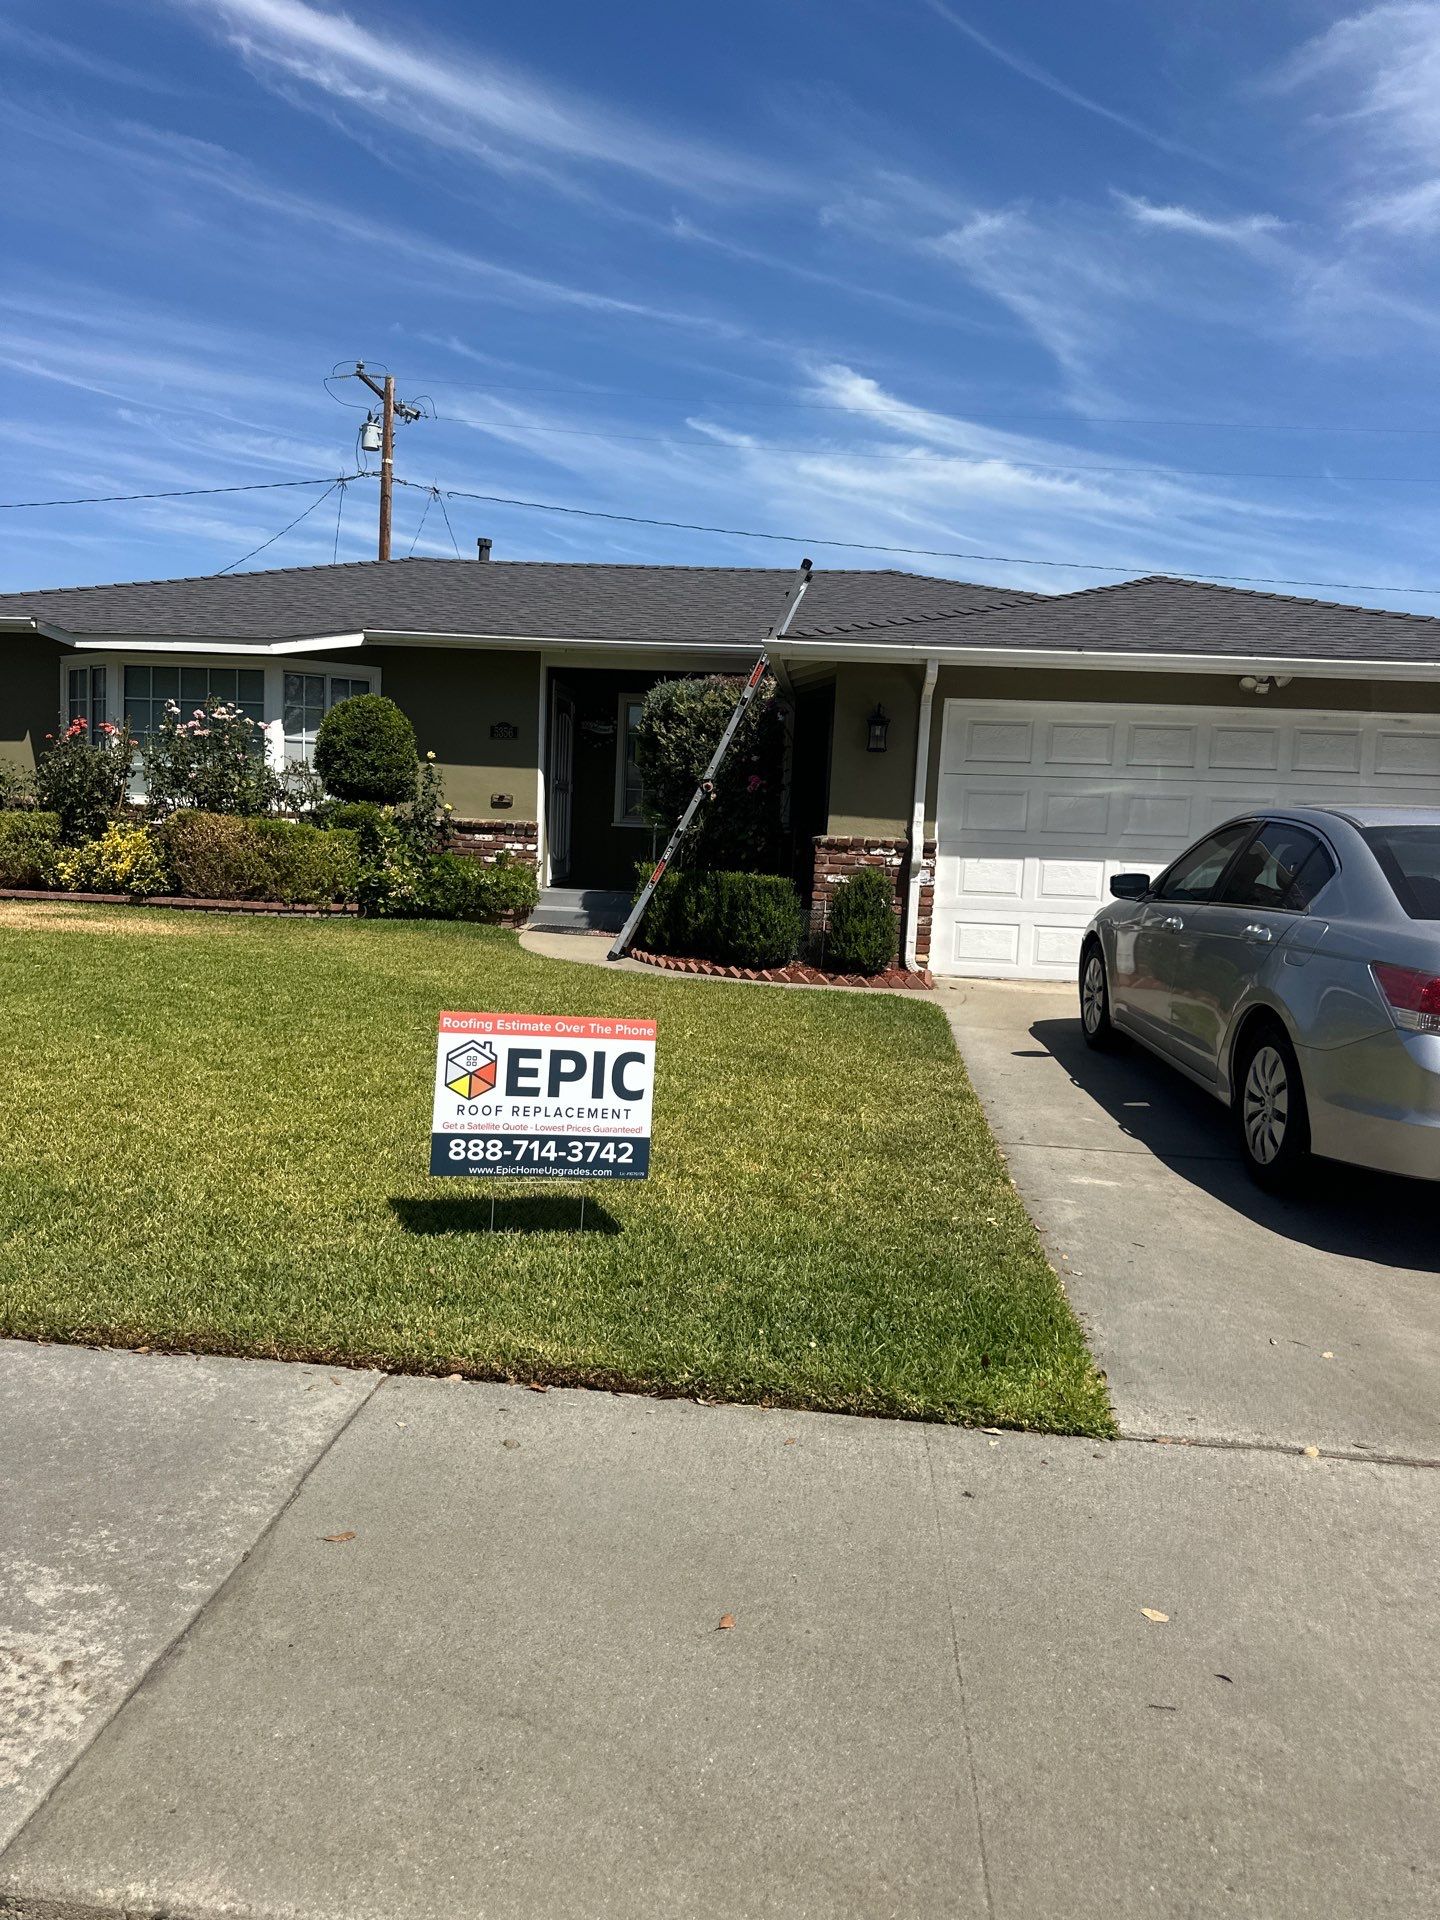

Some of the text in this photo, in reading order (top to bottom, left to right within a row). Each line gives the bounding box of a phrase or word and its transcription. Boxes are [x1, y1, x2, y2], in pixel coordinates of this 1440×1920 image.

[443, 1018, 654, 1036] Roofing Estimate Over The Phone
[505, 1047, 646, 1101] EPIC
[456, 1104, 632, 1120] ROOF REPLACEMENT
[442, 1121, 458, 1130] Get
[467, 1121, 500, 1131] Satellite
[502, 1122, 528, 1131] Quote
[535, 1123, 565, 1132] Lowest
[566, 1124, 591, 1133] Prices
[593, 1124, 643, 1134] Guaranteed!
[448, 1138, 634, 1164] 888-714-3742
[468, 1165, 613, 1177] www.EpicHomeUpgrades.com
